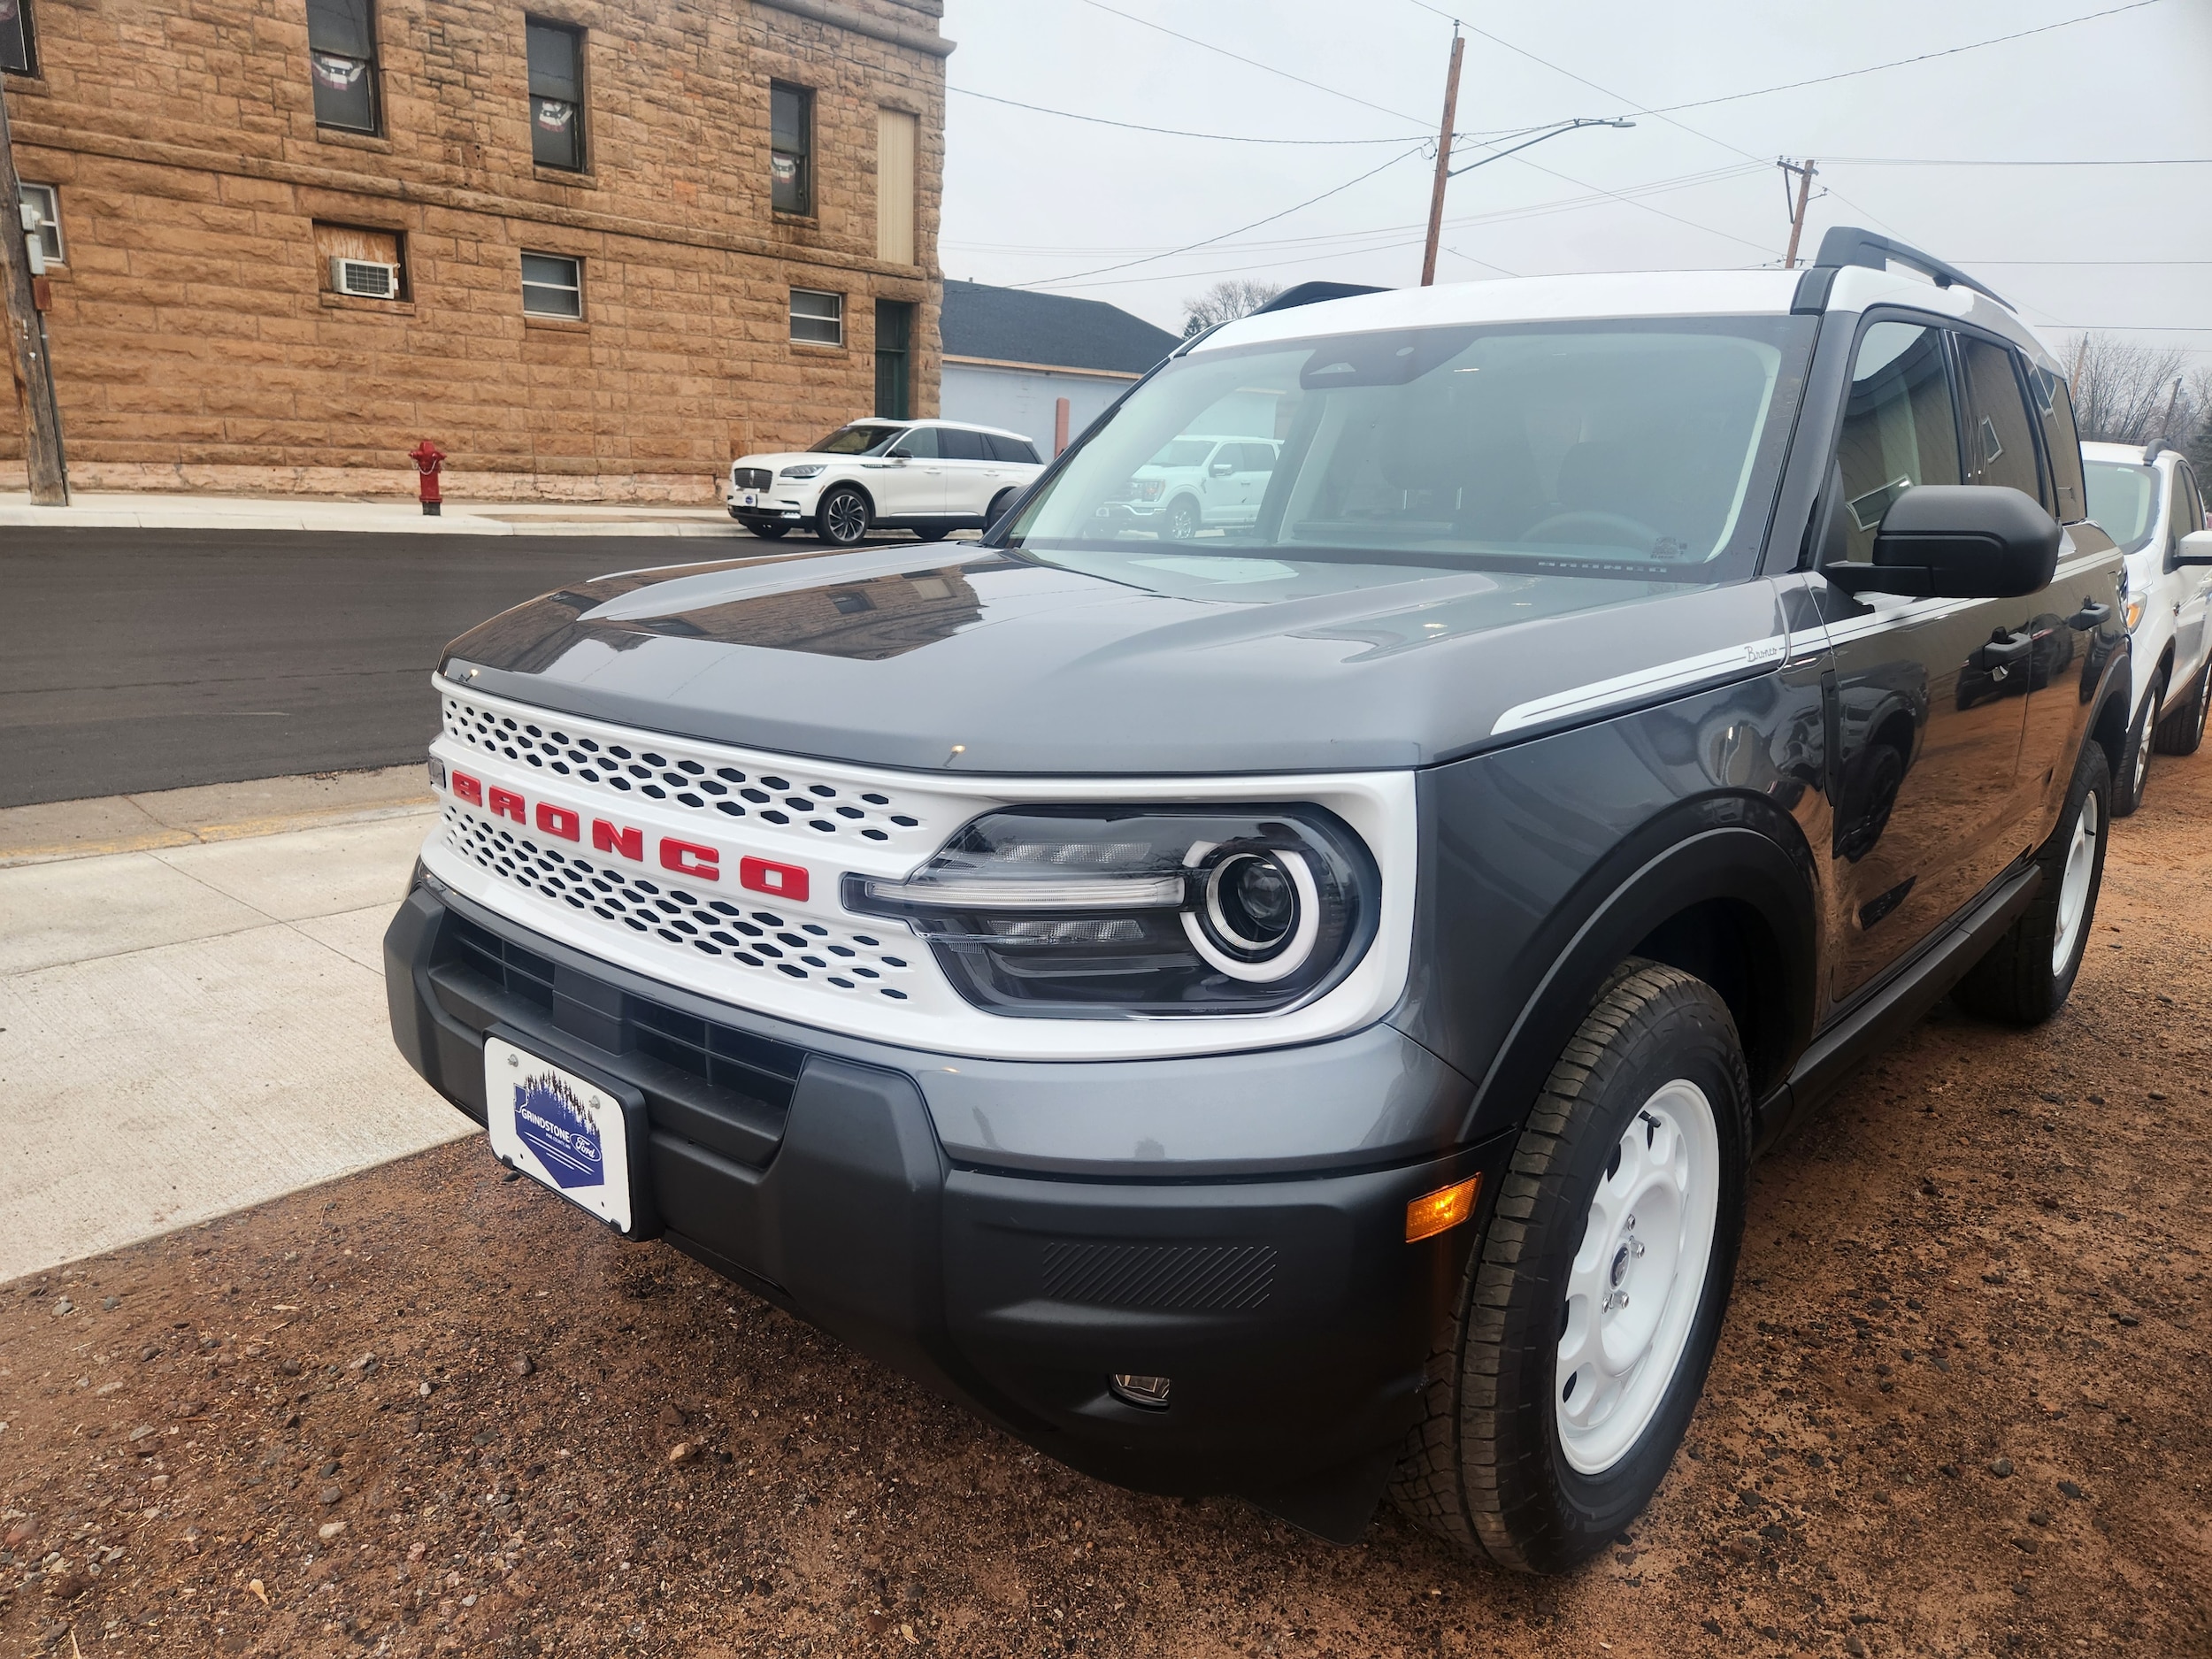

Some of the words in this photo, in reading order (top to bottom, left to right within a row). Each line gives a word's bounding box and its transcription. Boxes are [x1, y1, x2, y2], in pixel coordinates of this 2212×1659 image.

[1744, 646, 1777, 663] Bronco
[452, 770, 810, 902] BRONCO
[521, 1108, 571, 1143] GRINDSTONE
[574, 1136, 595, 1159] Ford
